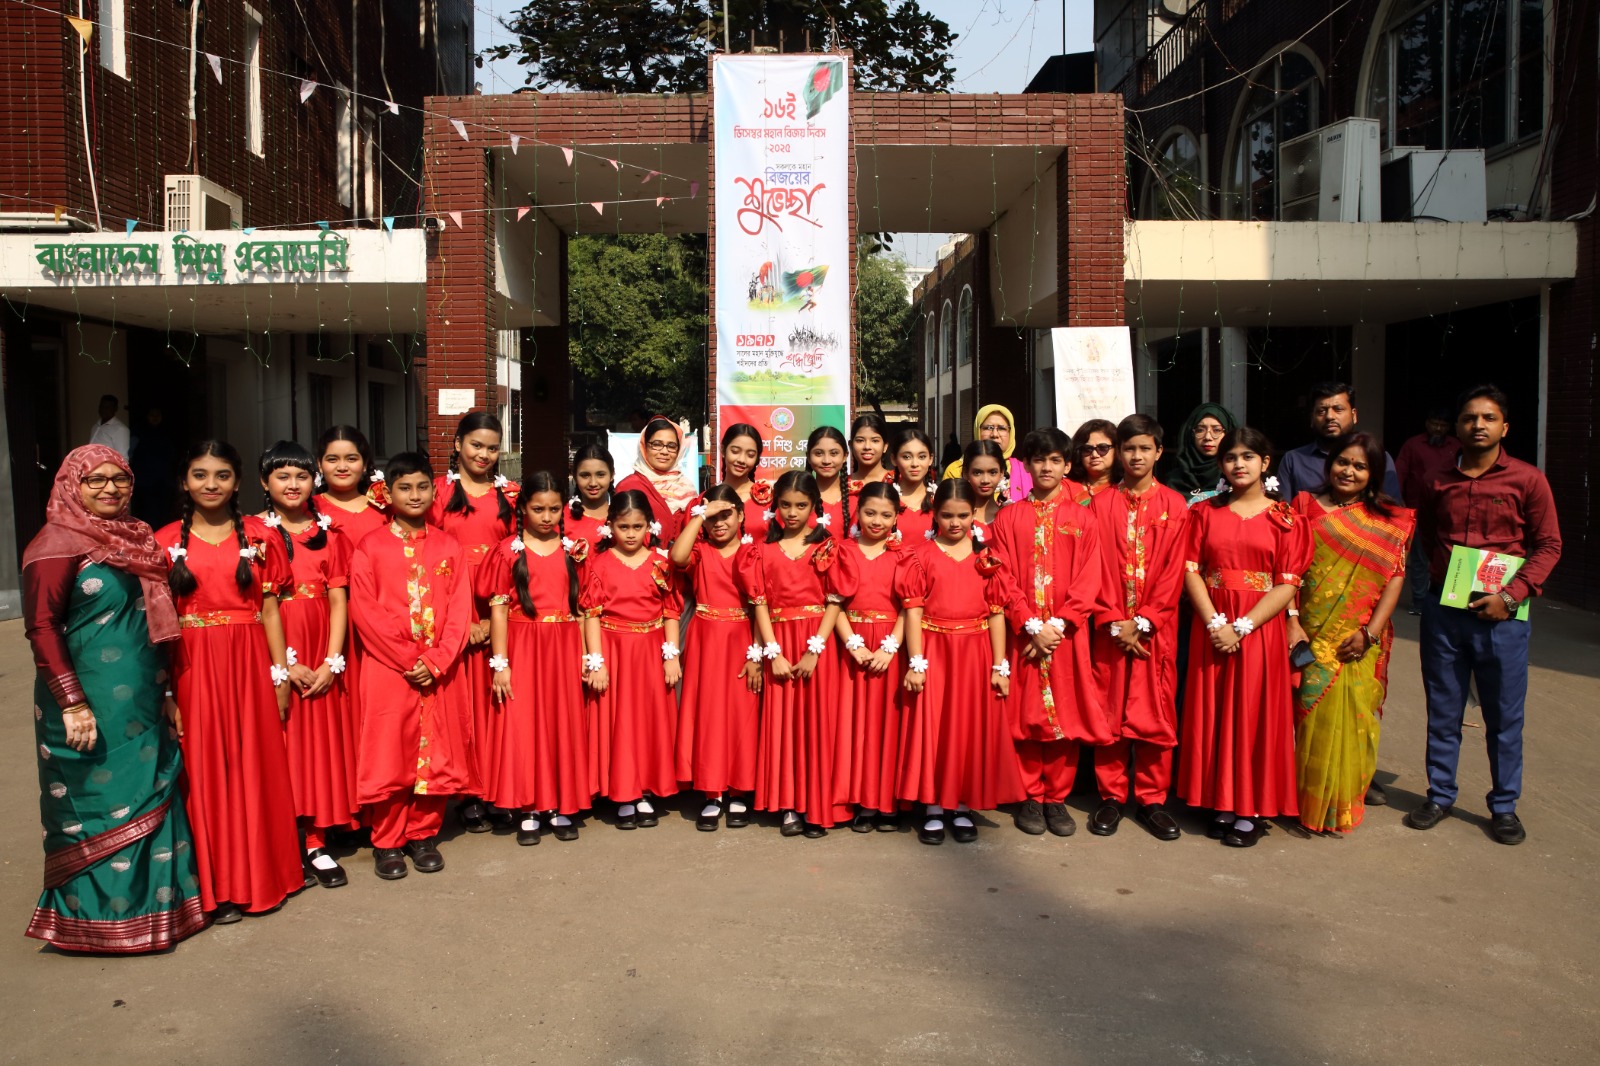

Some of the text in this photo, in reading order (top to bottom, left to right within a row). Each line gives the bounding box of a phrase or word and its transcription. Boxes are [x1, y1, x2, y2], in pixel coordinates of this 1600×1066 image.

[764, 91, 797, 120] ১৬ই
[734, 124, 826, 139] ডিসেম্বর মহান বিজয় দিবস
[769, 143, 791, 153] ২০২৫
[764, 166, 811, 186] বিজয়ের
[734, 176, 826, 235] শুভেচ্ছা
[34, 230, 348, 285] বাংলাদেশ শিশু একাডেমি
[737, 335, 774, 347] ১৯৭১
[773, 435, 793, 452] শিশু
